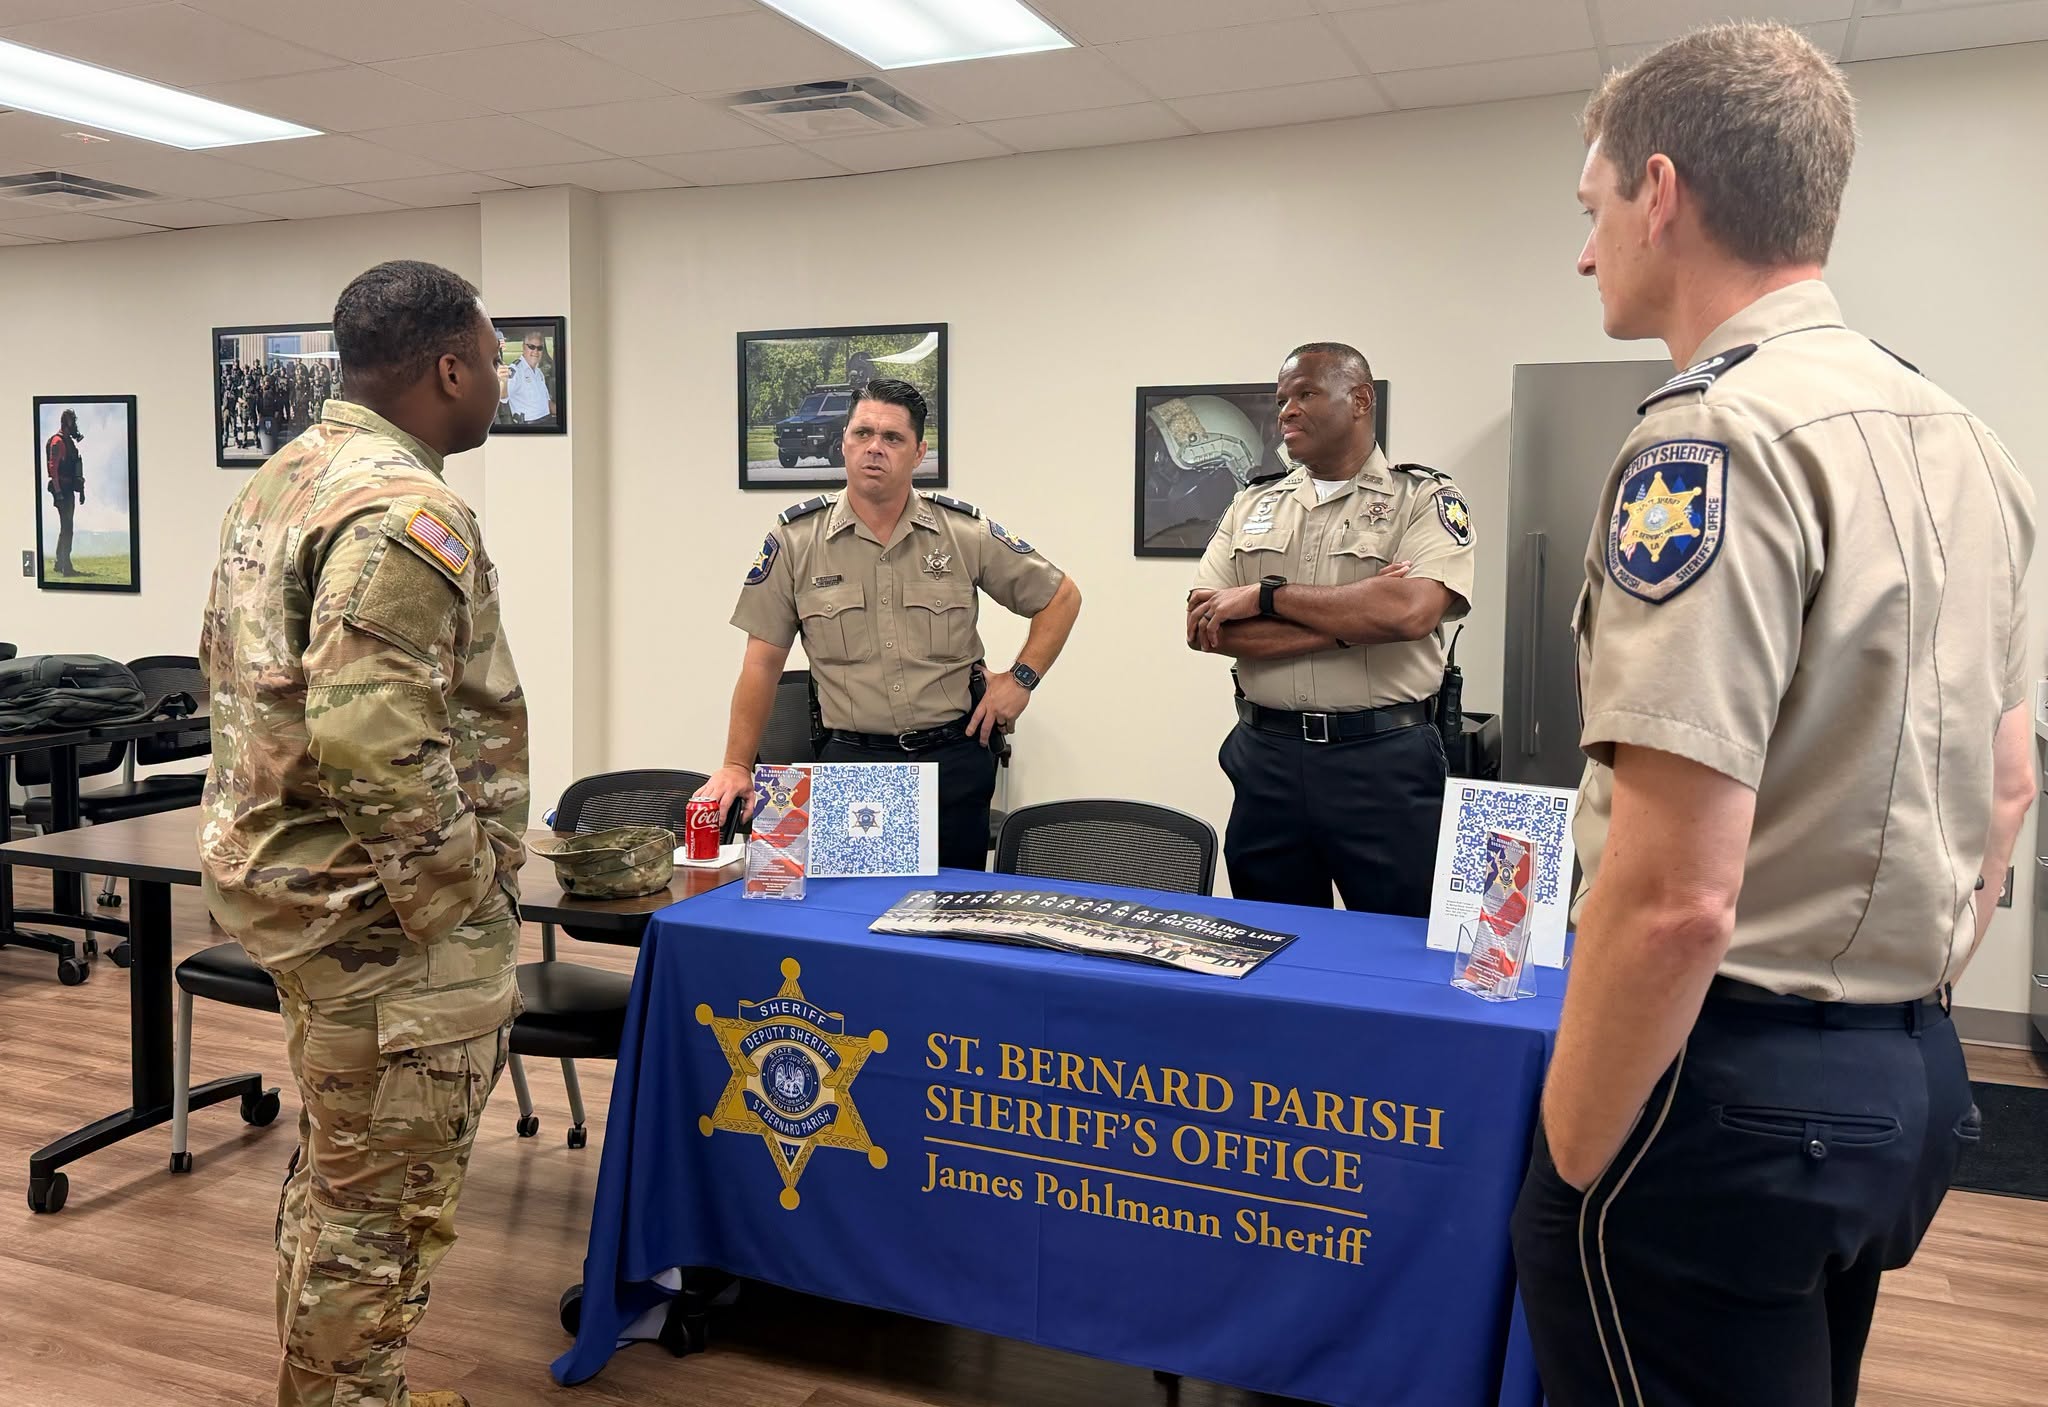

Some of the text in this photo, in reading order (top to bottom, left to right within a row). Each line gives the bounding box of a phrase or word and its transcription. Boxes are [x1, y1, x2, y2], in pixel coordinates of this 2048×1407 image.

[1660, 446, 1721, 464] SHERIFF
[1676, 498, 1720, 582] SHERIFF'S OFFICE
[1160, 918, 1184, 926] NO
[1185, 923, 1237, 940] OTHER
[1182, 916, 1248, 935] CALLING
[1247, 931, 1286, 943] LIKE
[760, 1002, 826, 1026] SHERIFF
[745, 1026, 836, 1060] DEPUTY SHERIFF
[769, 1047, 812, 1066] STATE OF
[770, 1056, 784, 1072] UNION
[925, 1032, 1444, 1149] ST. BERNARD PARISH
[769, 1094, 811, 1113] LOUISIANA
[752, 1099, 832, 1136] ST BERNARD PARISH
[785, 1146, 795, 1157] LA
[1171, 1125, 1364, 1193] OFFICE
[921, 1152, 1373, 1265] James Pohlmann Sheriff
